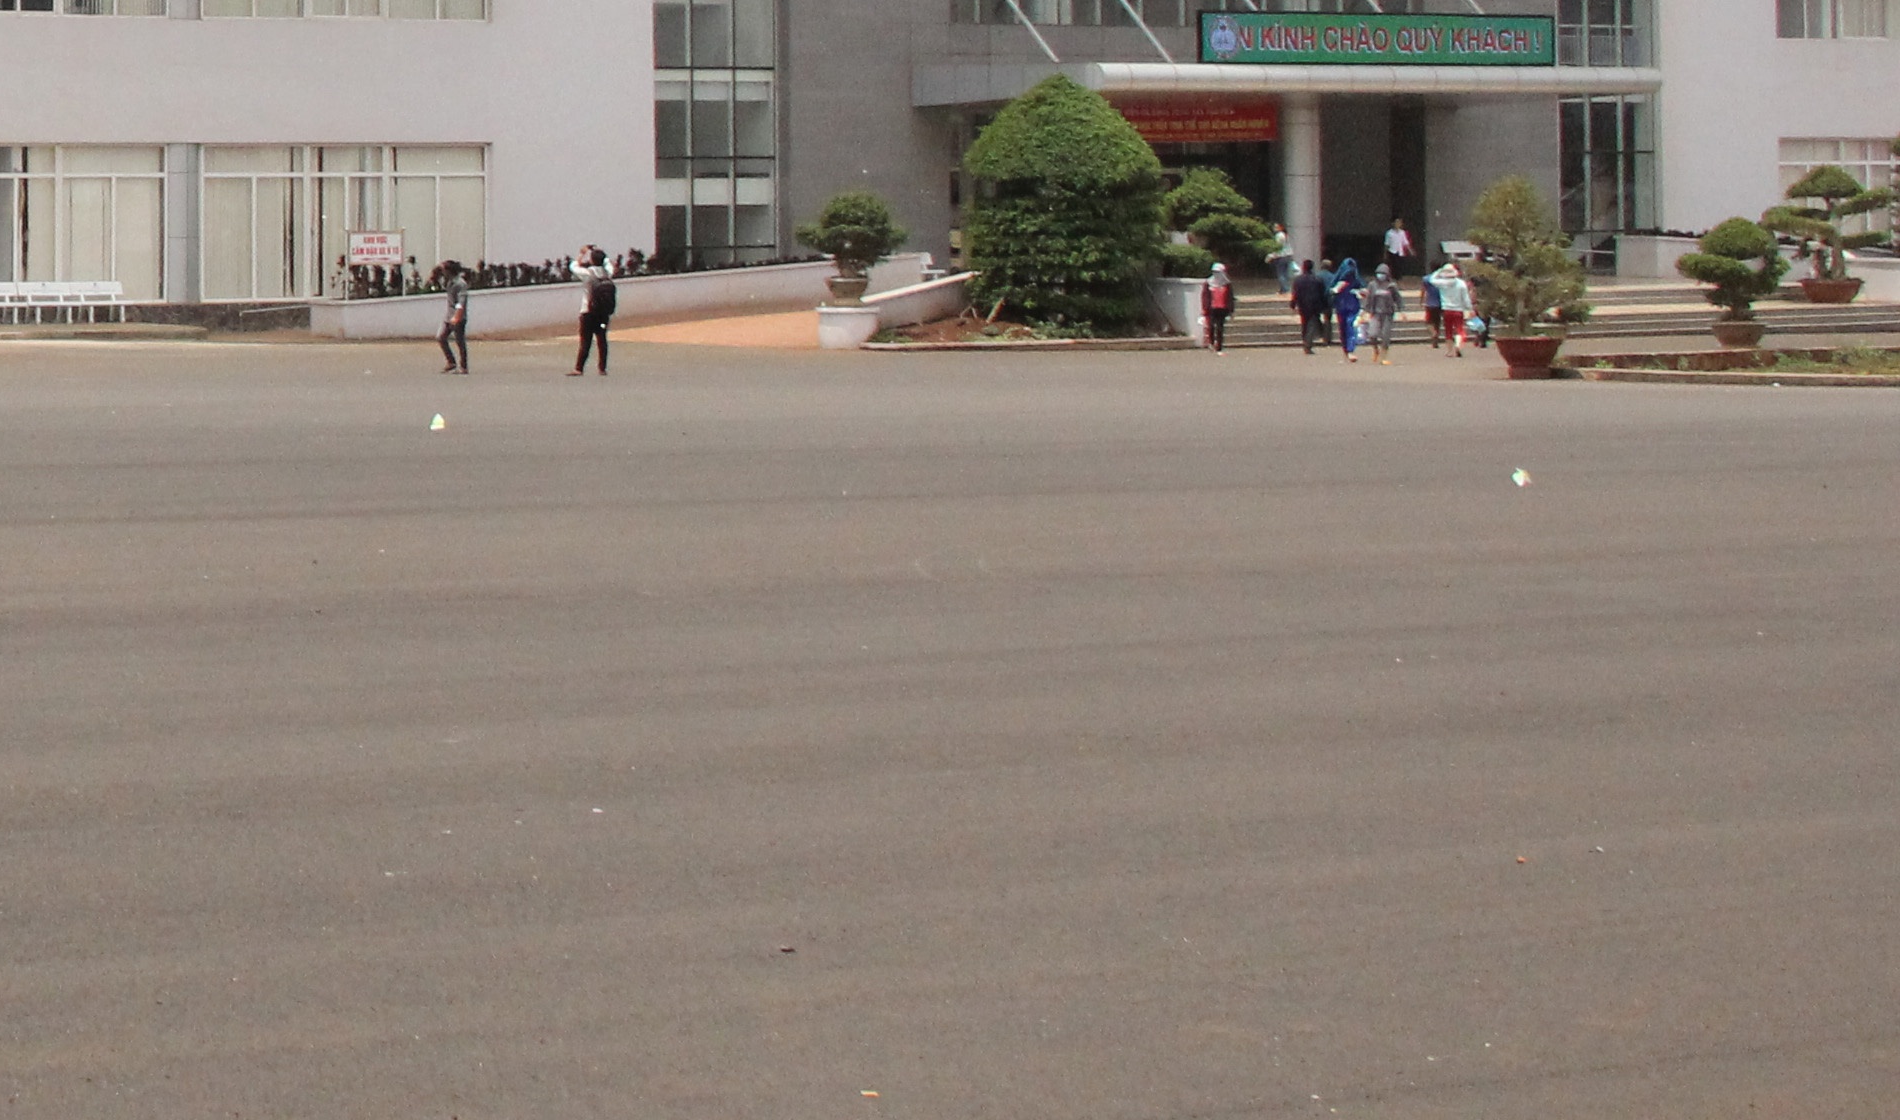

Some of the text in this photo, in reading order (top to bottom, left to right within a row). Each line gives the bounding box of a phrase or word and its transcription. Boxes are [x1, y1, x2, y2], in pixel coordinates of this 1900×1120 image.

[1259, 20, 1317, 52] KÍNH
[1322, 21, 1391, 53] CHÀO
[1450, 25, 1529, 54] KHÁCH
